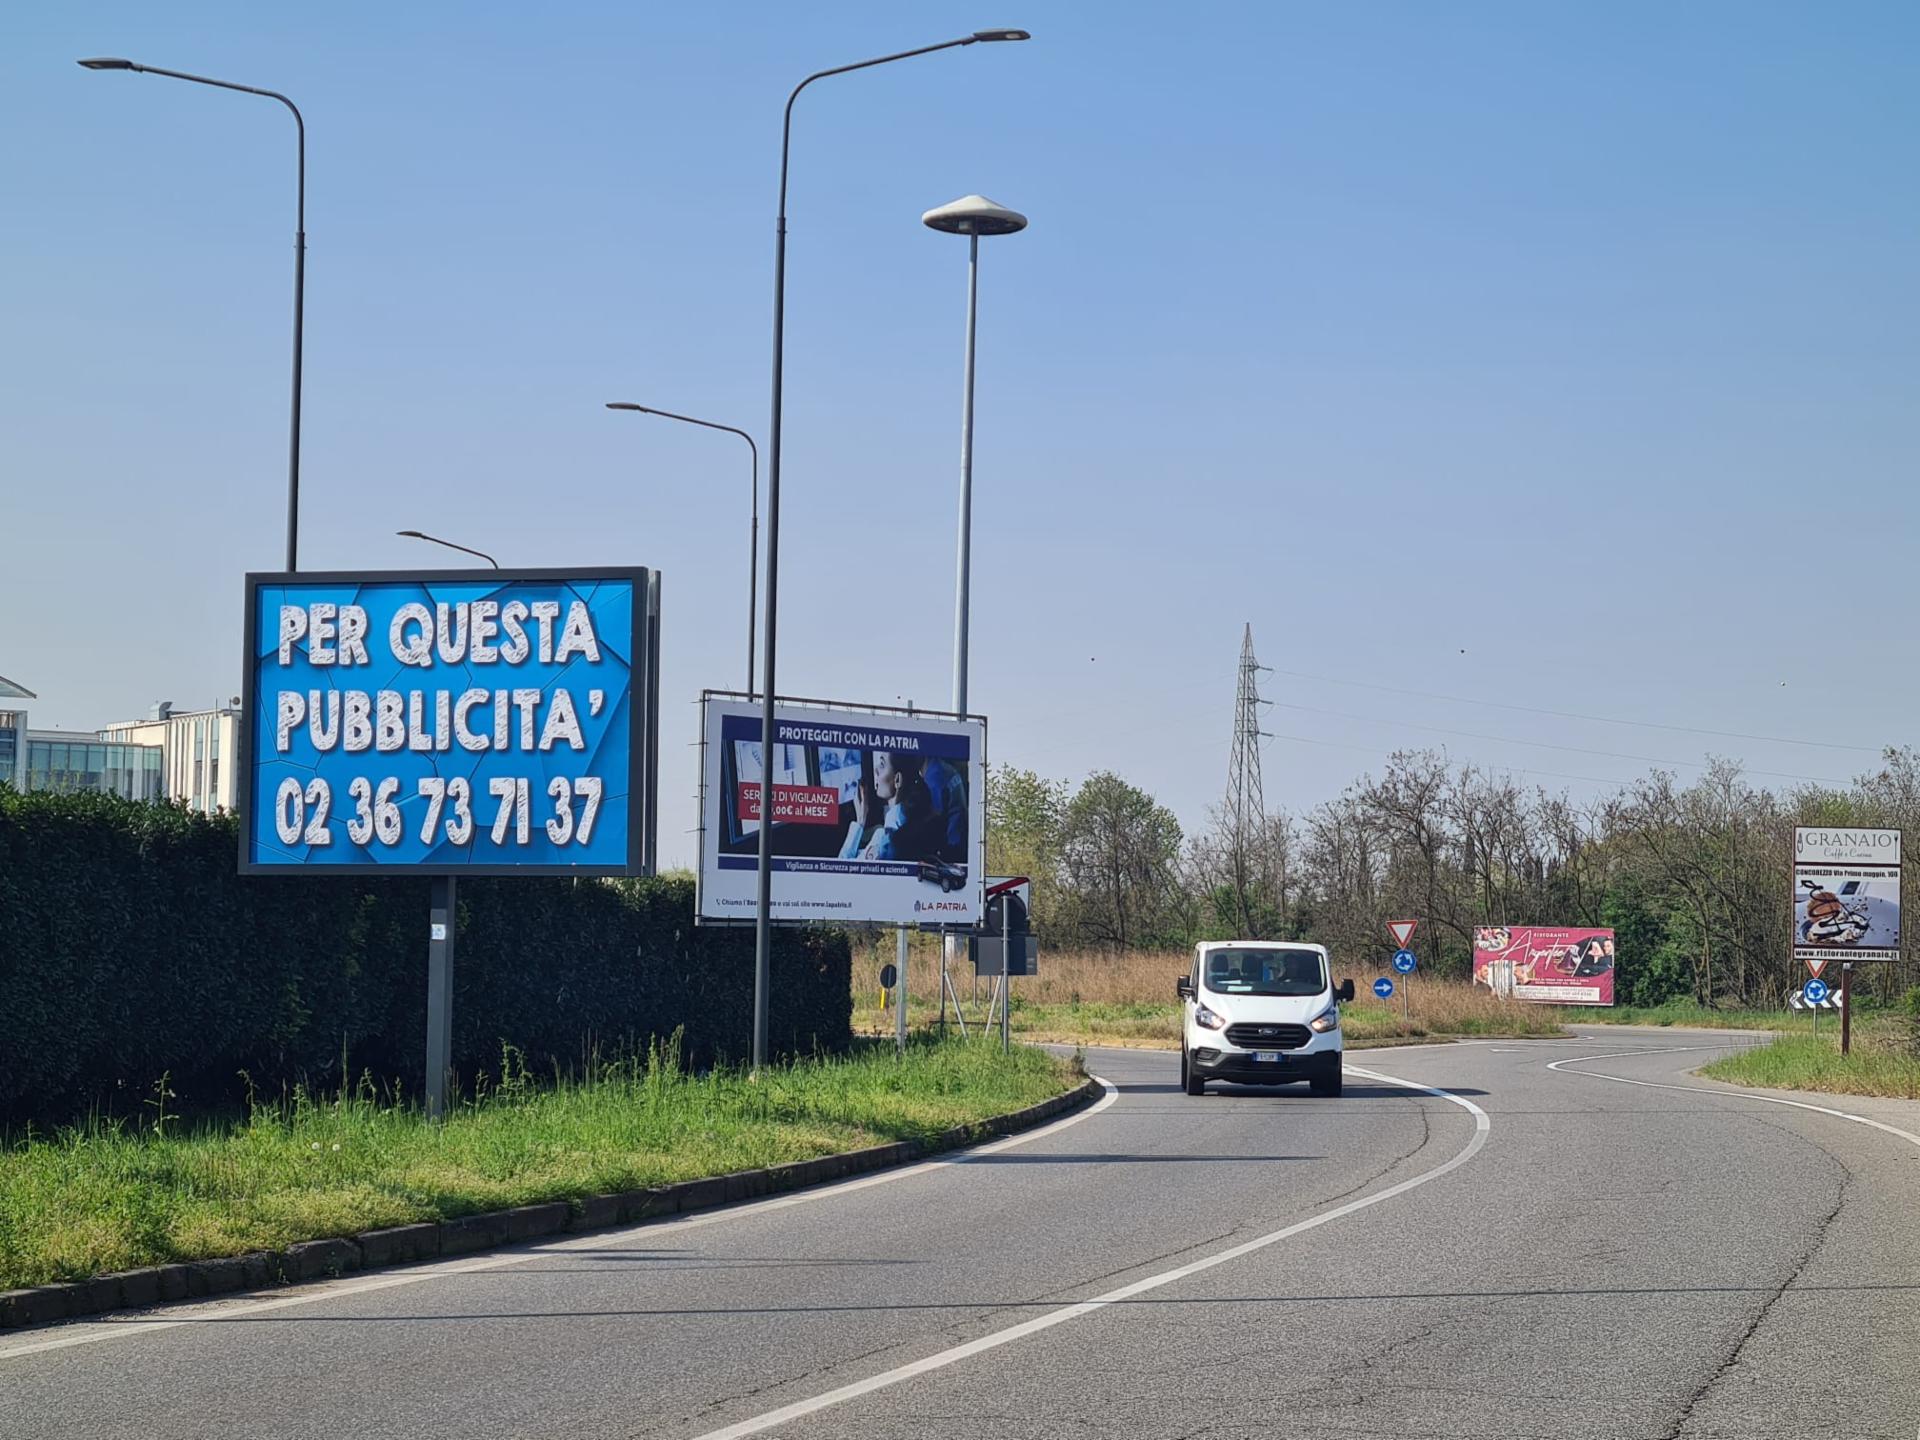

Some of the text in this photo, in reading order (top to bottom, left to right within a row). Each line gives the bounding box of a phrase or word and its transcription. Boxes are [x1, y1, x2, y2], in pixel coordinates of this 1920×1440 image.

[278, 600, 601, 667] PER QUESTA
[276, 688, 604, 752] PUBBLICITA'
[779, 726, 919, 750] PROTEGGITI CON LA PATRIA
[779, 791, 788, 802] DI
[789, 791, 834, 804] VIGILANZA
[275, 776, 602, 846] 02 36 73 71 37
[794, 806, 803, 816] al
[804, 806, 828, 817] MESE
[1805, 832, 1892, 848] GRANAIO
[785, 861, 814, 872] Vigilanza
[819, 862, 849, 871] Sicurezza
[849, 865, 860, 873] per
[860, 864, 880, 874] privati
[885, 866, 908, 874] aziende
[1833, 869, 1844, 877] Via
[921, 901, 968, 911] LA PATRIA
[1795, 949, 1898, 960] www.ristorantegranaio.it
